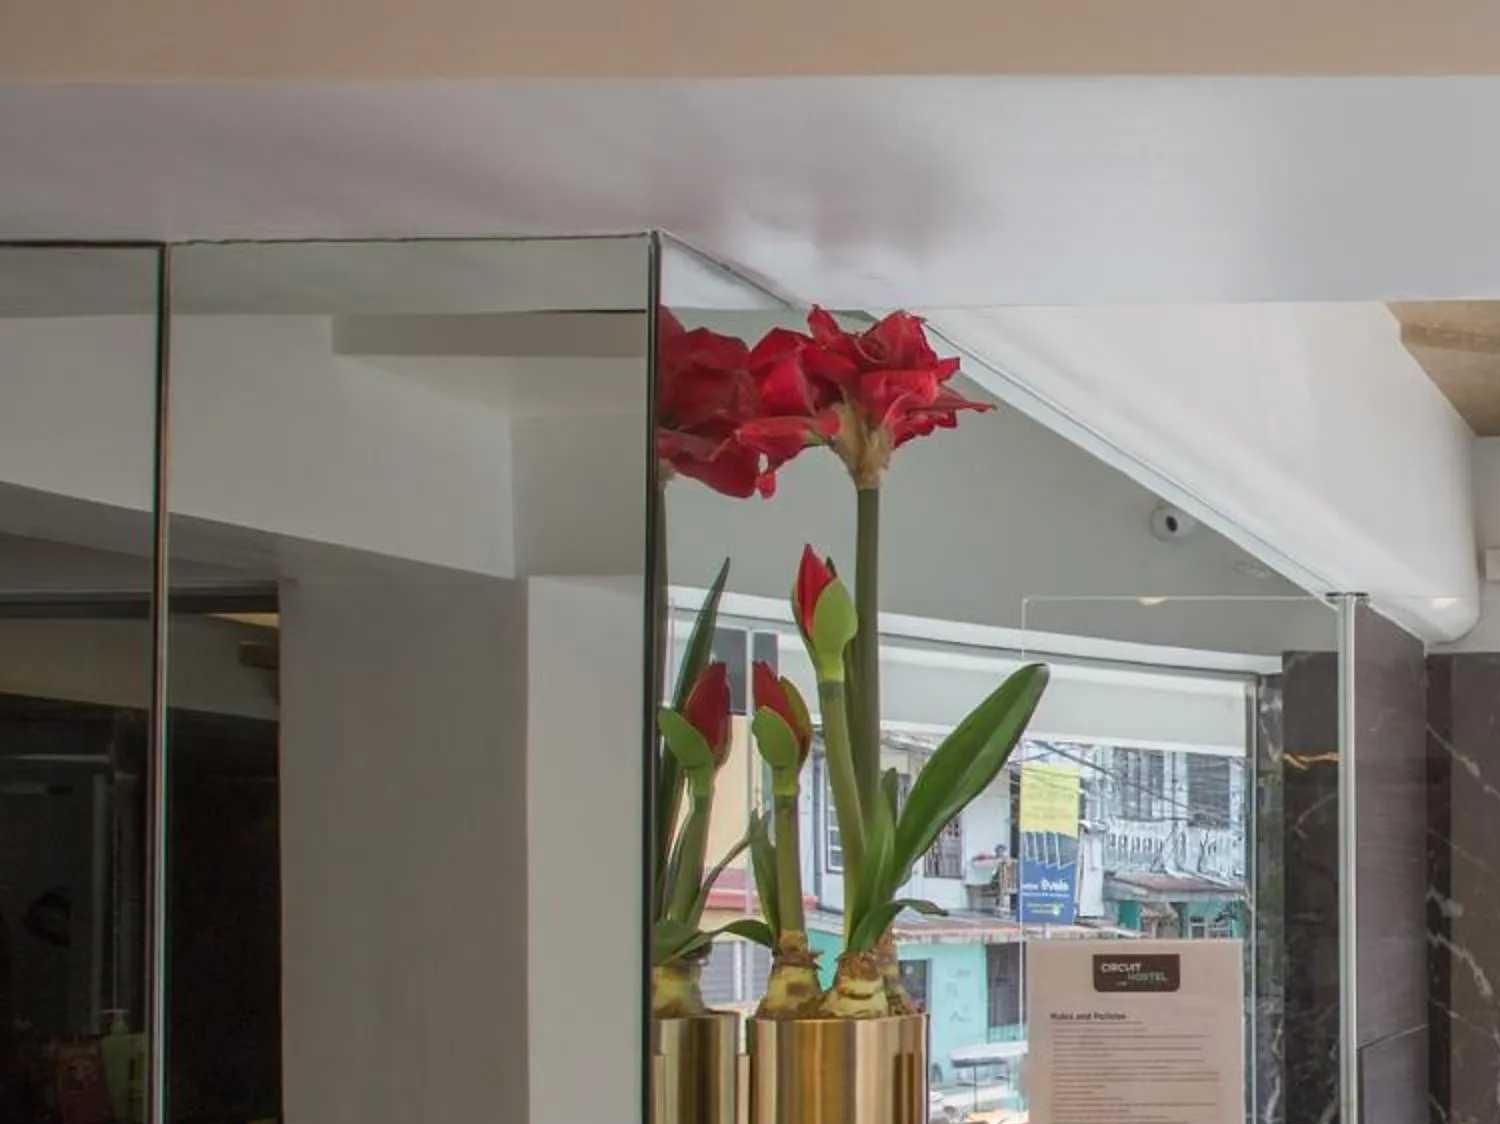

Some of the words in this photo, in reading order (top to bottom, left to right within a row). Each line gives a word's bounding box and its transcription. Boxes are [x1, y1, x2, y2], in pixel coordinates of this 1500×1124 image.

[1100, 962, 1142, 973] CIRCUIT
[1127, 971, 1168, 982] HOSTEL
[1076, 1011, 1091, 1020] and
